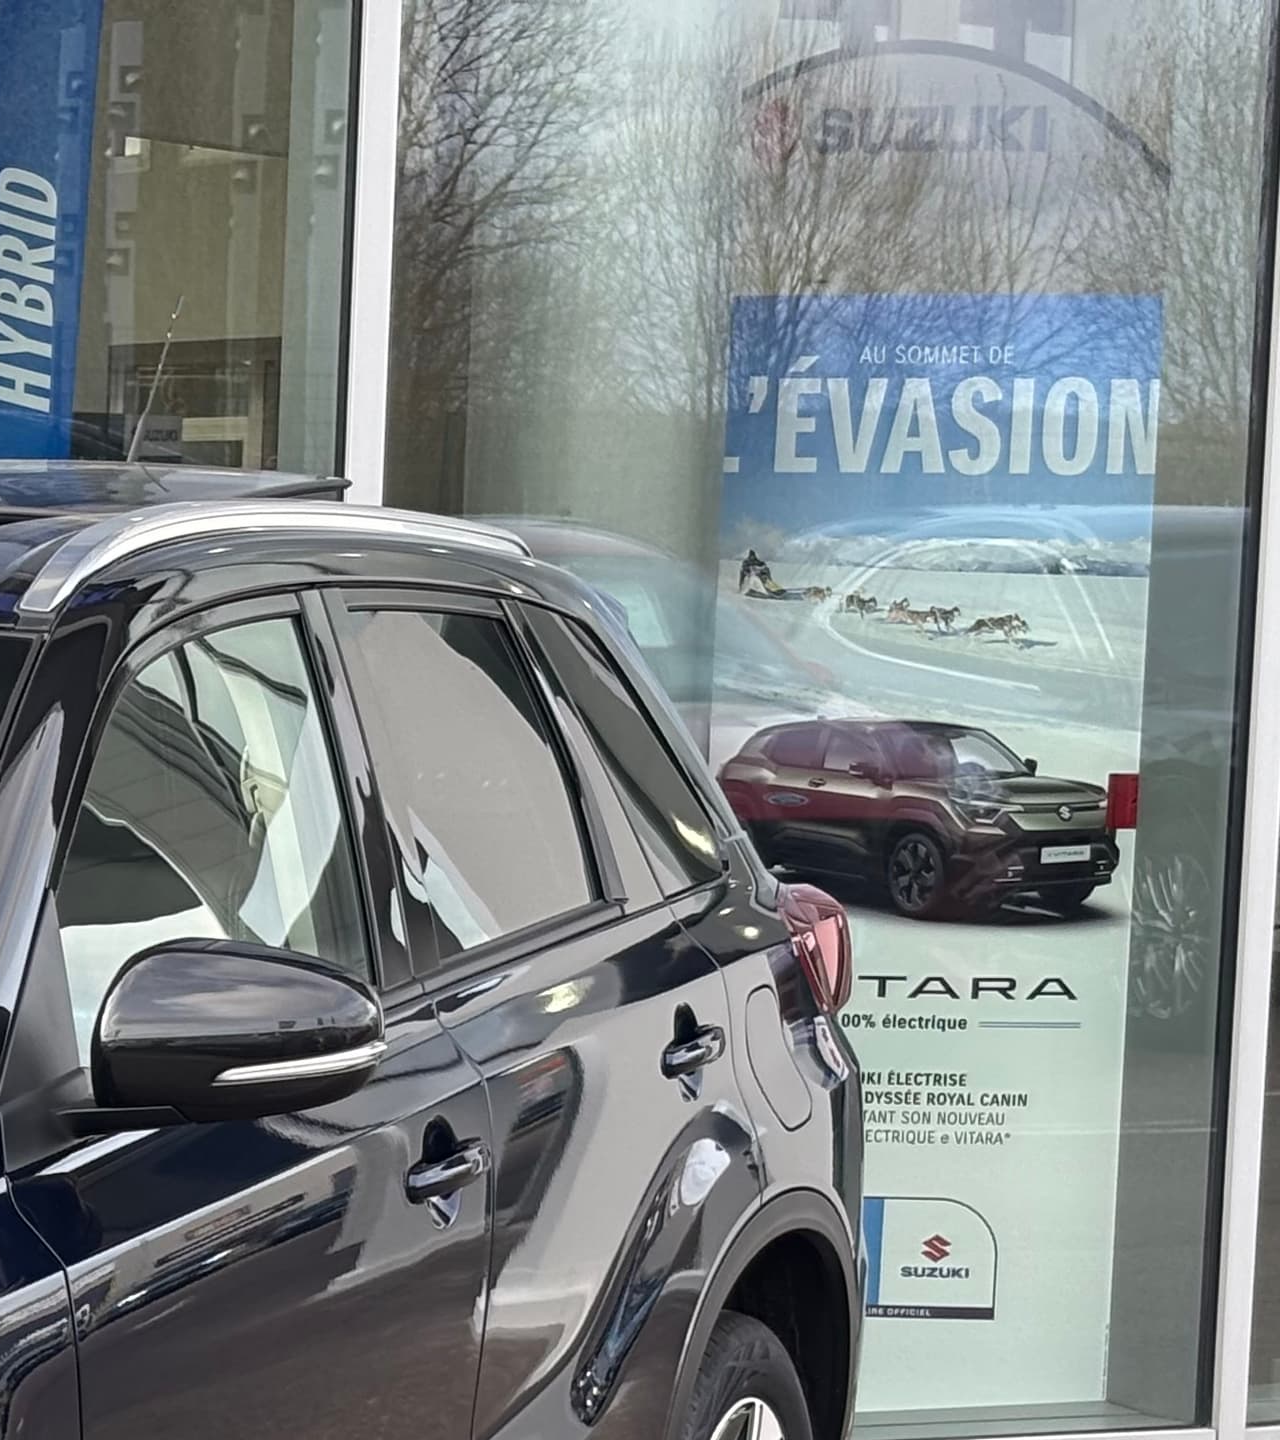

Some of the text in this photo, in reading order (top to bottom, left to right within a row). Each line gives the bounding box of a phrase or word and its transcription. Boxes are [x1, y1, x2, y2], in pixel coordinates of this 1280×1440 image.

[859, 345, 1015, 365] AU SOMMET DE
[857, 974, 1078, 1000] TARA
[841, 1013, 968, 1032] 00% électrique
[887, 1069, 967, 1087] ÉLECTRISE
[864, 1089, 1028, 1107] DYSSÉE ROYAL CANIN
[900, 1110, 932, 1125] SON
[936, 1112, 1006, 1126] NOUVEAU
[865, 1128, 936, 1144] ECTRIQUE
[940, 1133, 950, 1144] e
[899, 1265, 970, 1279] SUZUKI
